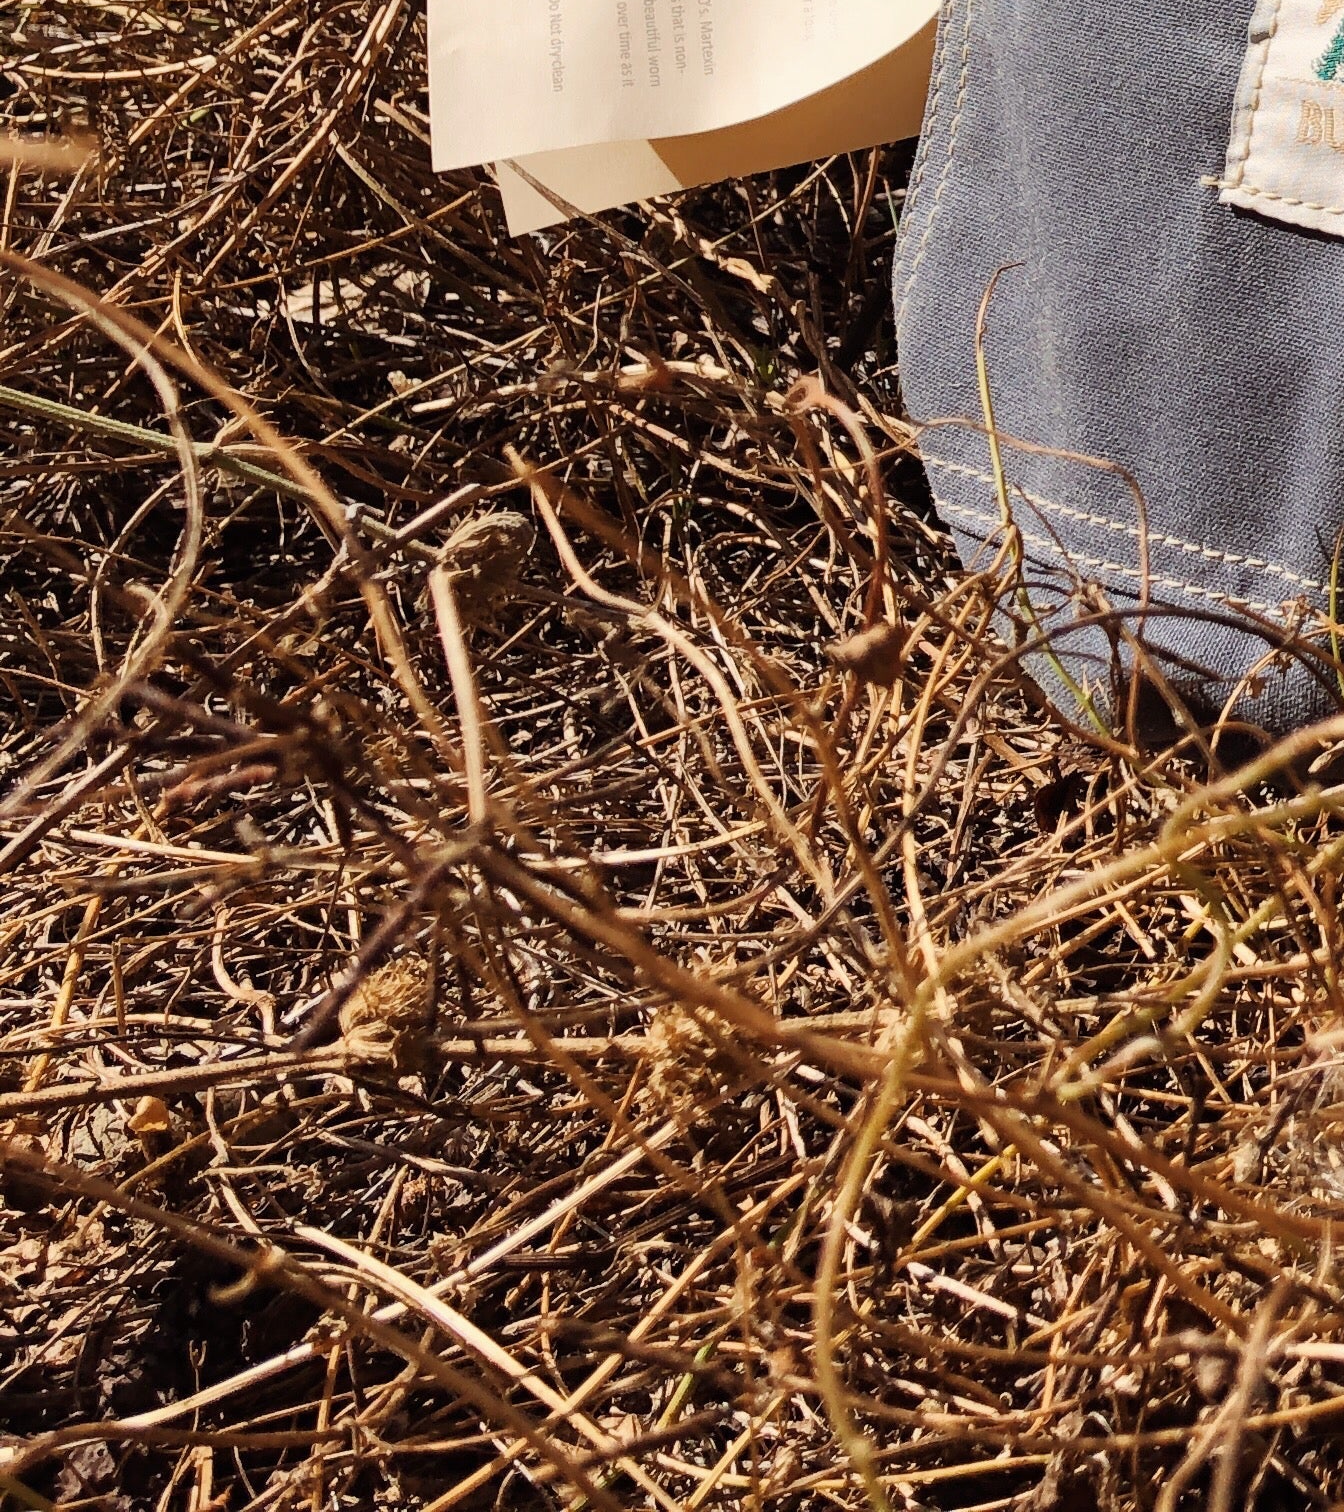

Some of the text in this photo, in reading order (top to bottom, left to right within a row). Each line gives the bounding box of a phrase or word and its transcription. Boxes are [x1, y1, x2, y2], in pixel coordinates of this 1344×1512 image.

[550, 14, 563, 36] Not
[616, 2, 629, 28] over
[643, 0, 661, 53] beautiful
[671, 5, 685, 30] that
[618, 30, 633, 60] time
[674, 34, 686, 43] is
[700, 21, 714, 76] Martexin
[620, 62, 633, 78] as
[648, 55, 661, 88] worn
[622, 79, 636, 88] it
